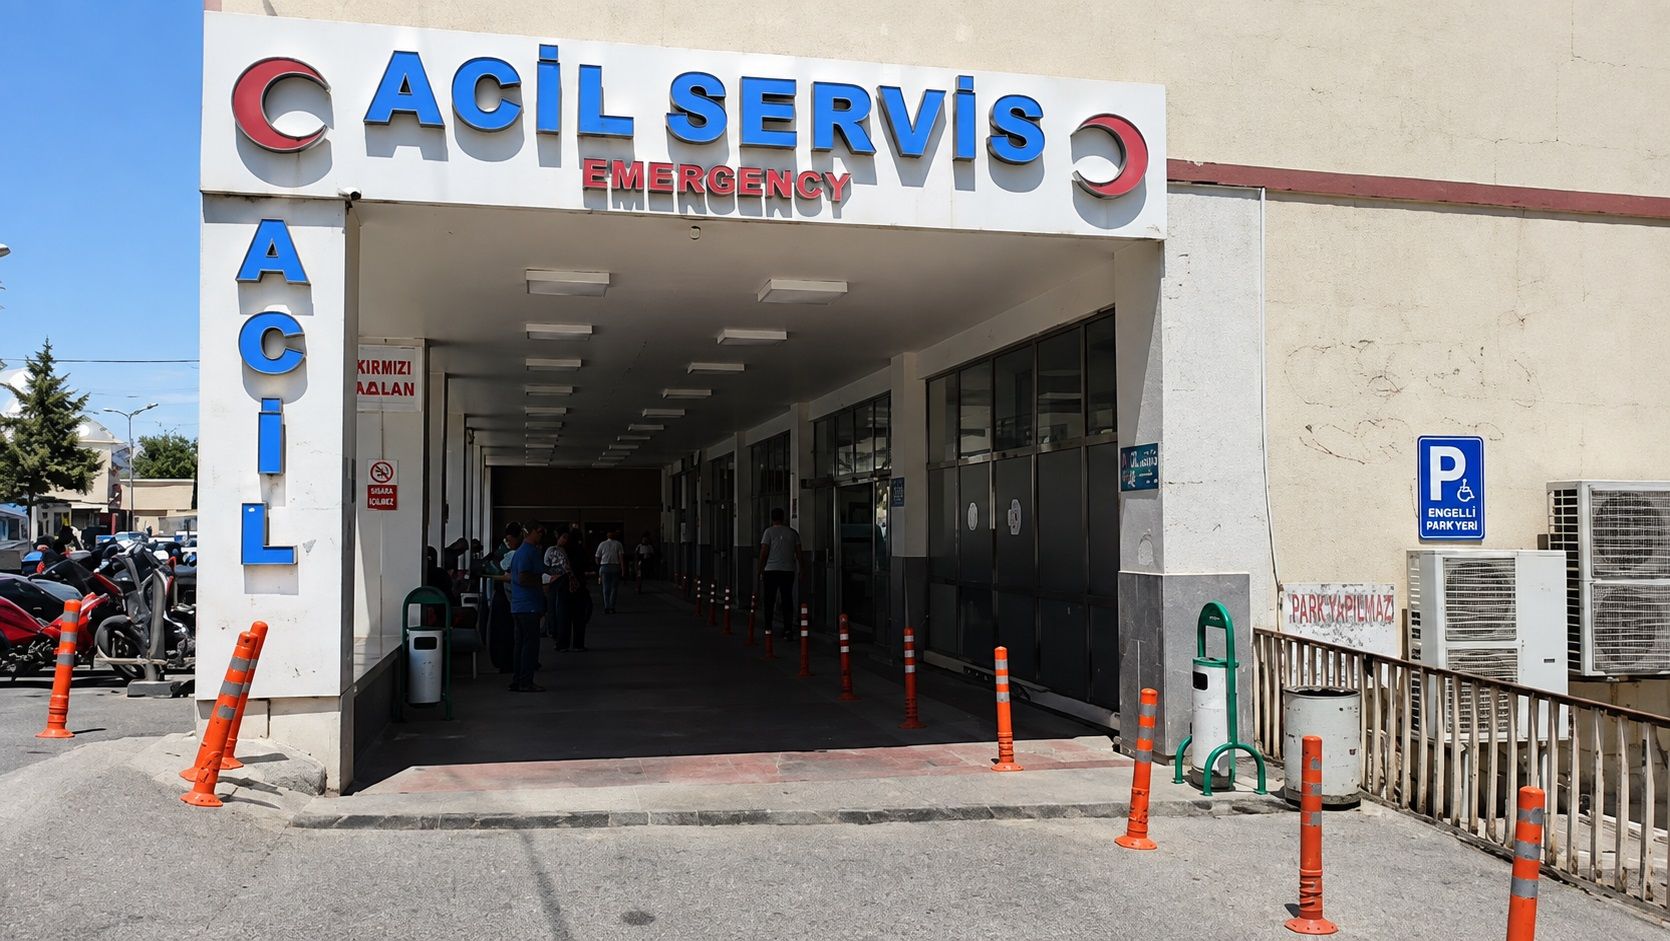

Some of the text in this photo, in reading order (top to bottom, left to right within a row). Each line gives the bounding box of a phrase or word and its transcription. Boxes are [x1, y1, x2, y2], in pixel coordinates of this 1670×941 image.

[363, 44, 1046, 165] ACİL SERVİS
[583, 158, 851, 203] EMERGENCY
[235, 218, 311, 565] ACİL
[1429, 446, 1466, 501] P
[1426, 521, 1454, 531] PARK
[1428, 506, 1476, 518] ENGELLİ
[1292, 593, 1394, 624] PARK YAPILMAZ
